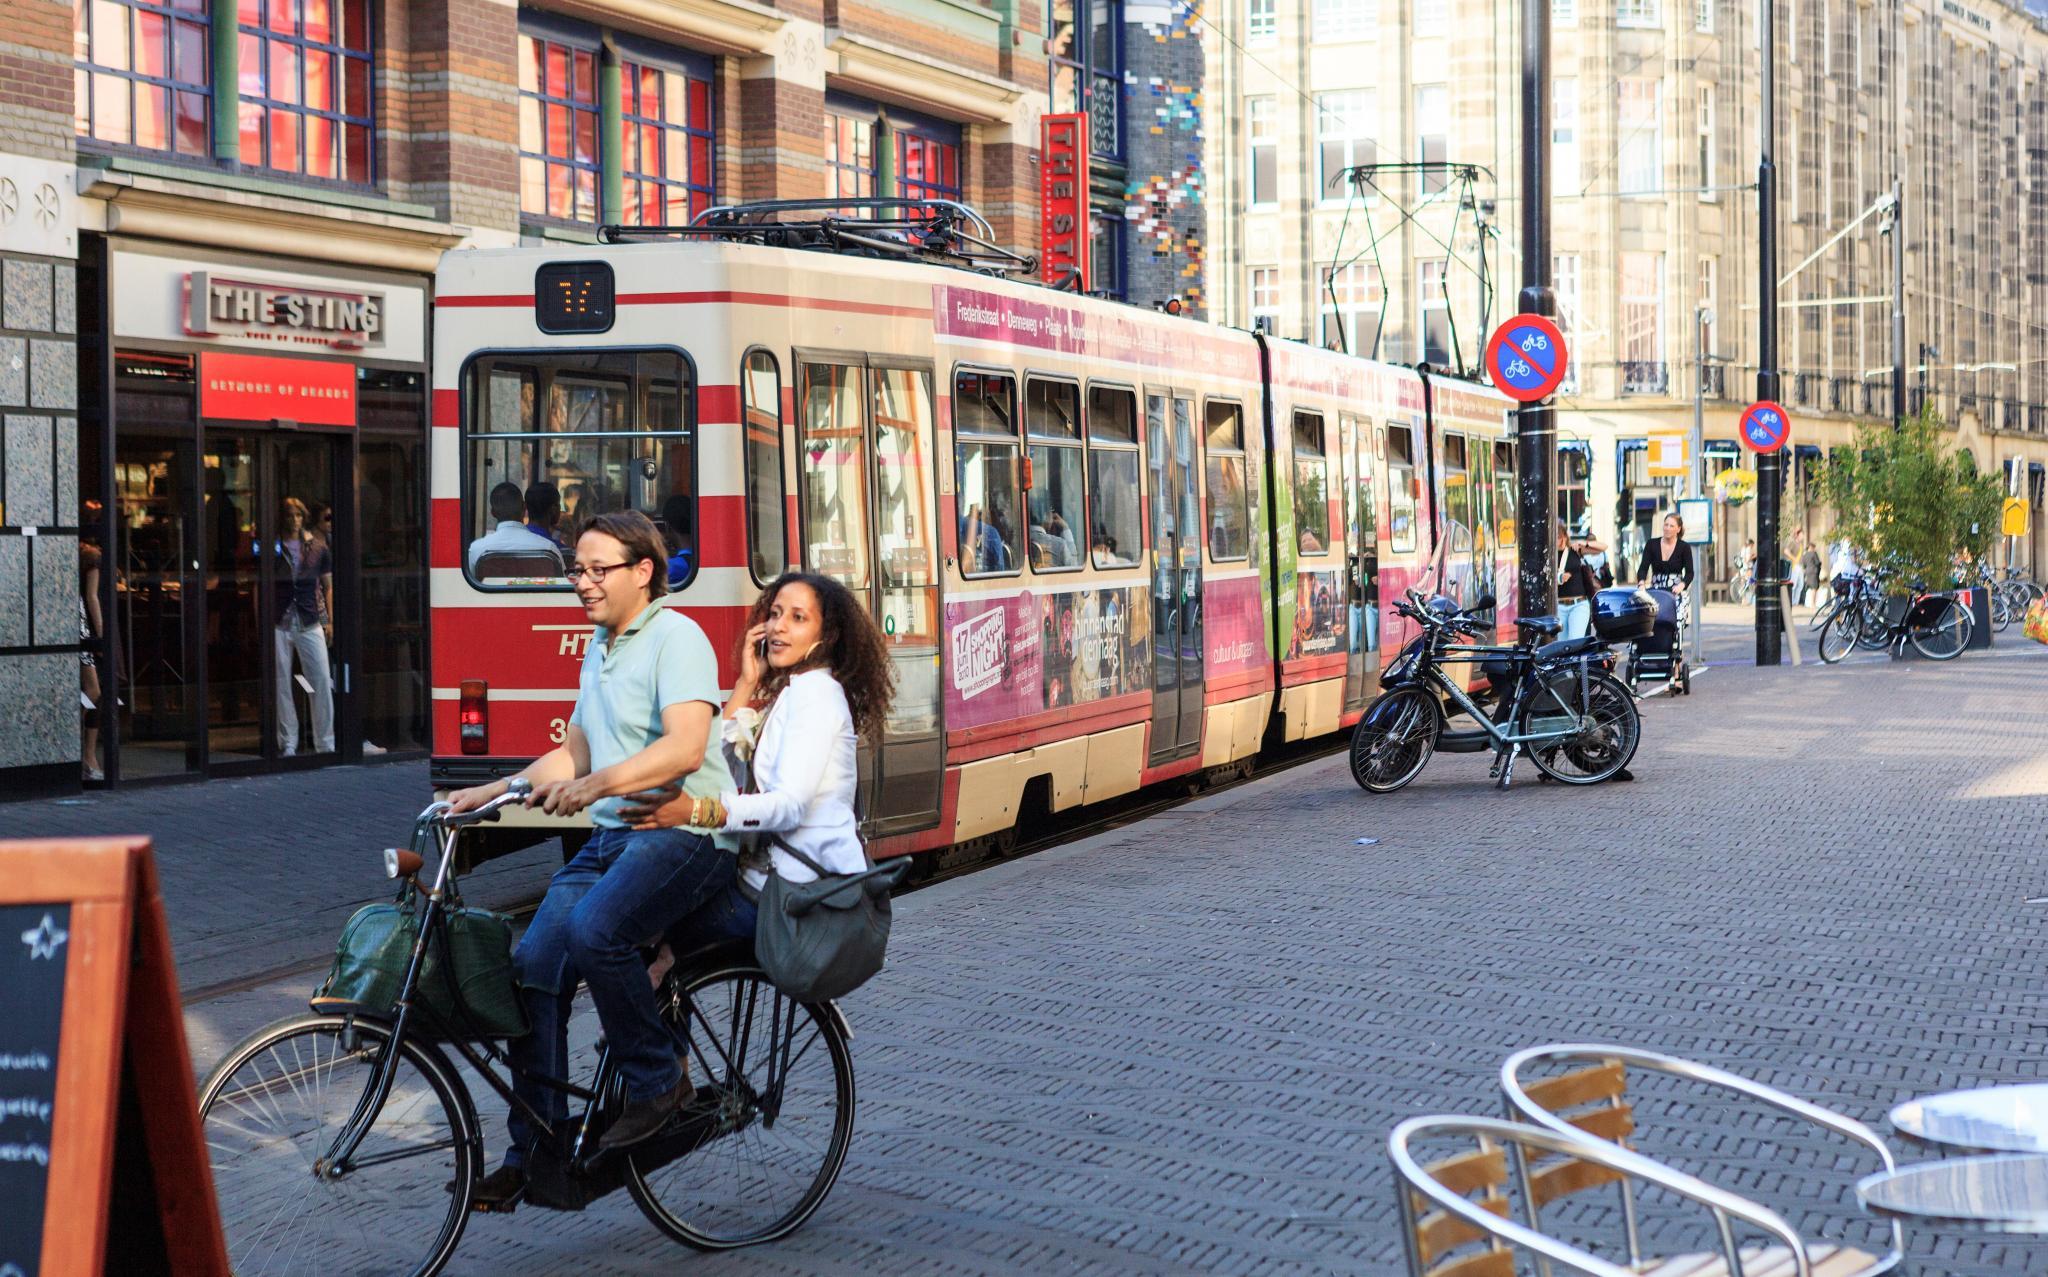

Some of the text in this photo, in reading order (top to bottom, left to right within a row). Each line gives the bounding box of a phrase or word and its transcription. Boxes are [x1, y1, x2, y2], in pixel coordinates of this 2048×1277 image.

[1052, 127, 1073, 200] THE
[213, 285, 379, 333] THE STING
[1007, 310, 1038, 337] Denneweg
[278, 383, 294, 396] OF
[301, 385, 349, 400] BRANDS
[558, 632, 594, 656] HT
[955, 629, 969, 656] 17
[971, 609, 1003, 653] SHOPPING
